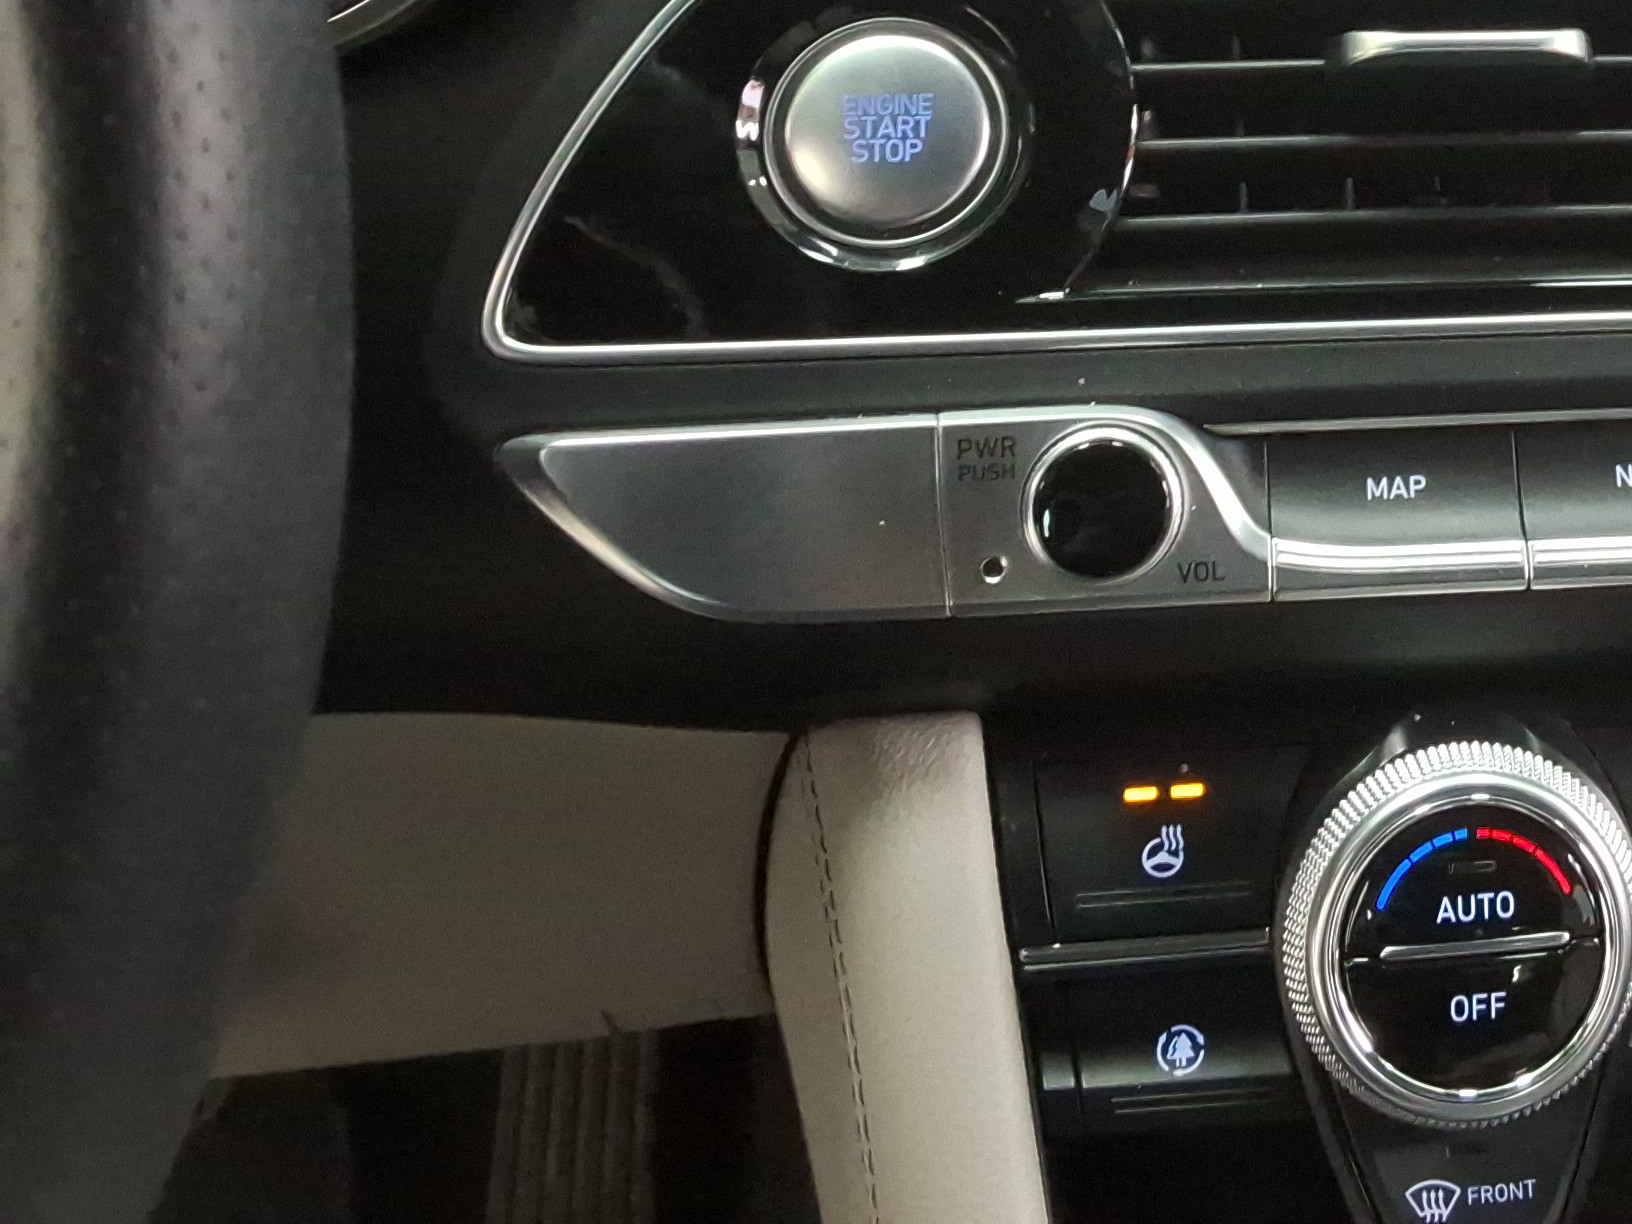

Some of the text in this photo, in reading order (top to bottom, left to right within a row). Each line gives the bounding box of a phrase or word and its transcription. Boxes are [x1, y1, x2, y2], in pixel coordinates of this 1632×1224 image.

[842, 92, 934, 116] ENGINE
[843, 116, 932, 140] START
[851, 139, 923, 163] STOP
[957, 437, 1017, 460] PWR
[957, 463, 1017, 481] PUSH
[1366, 475, 1426, 500] MAP
[1177, 561, 1226, 584] VOL
[1436, 890, 1516, 925] AUTO
[1449, 991, 1507, 1024] OFF
[1466, 1178, 1537, 1205] FRONT
